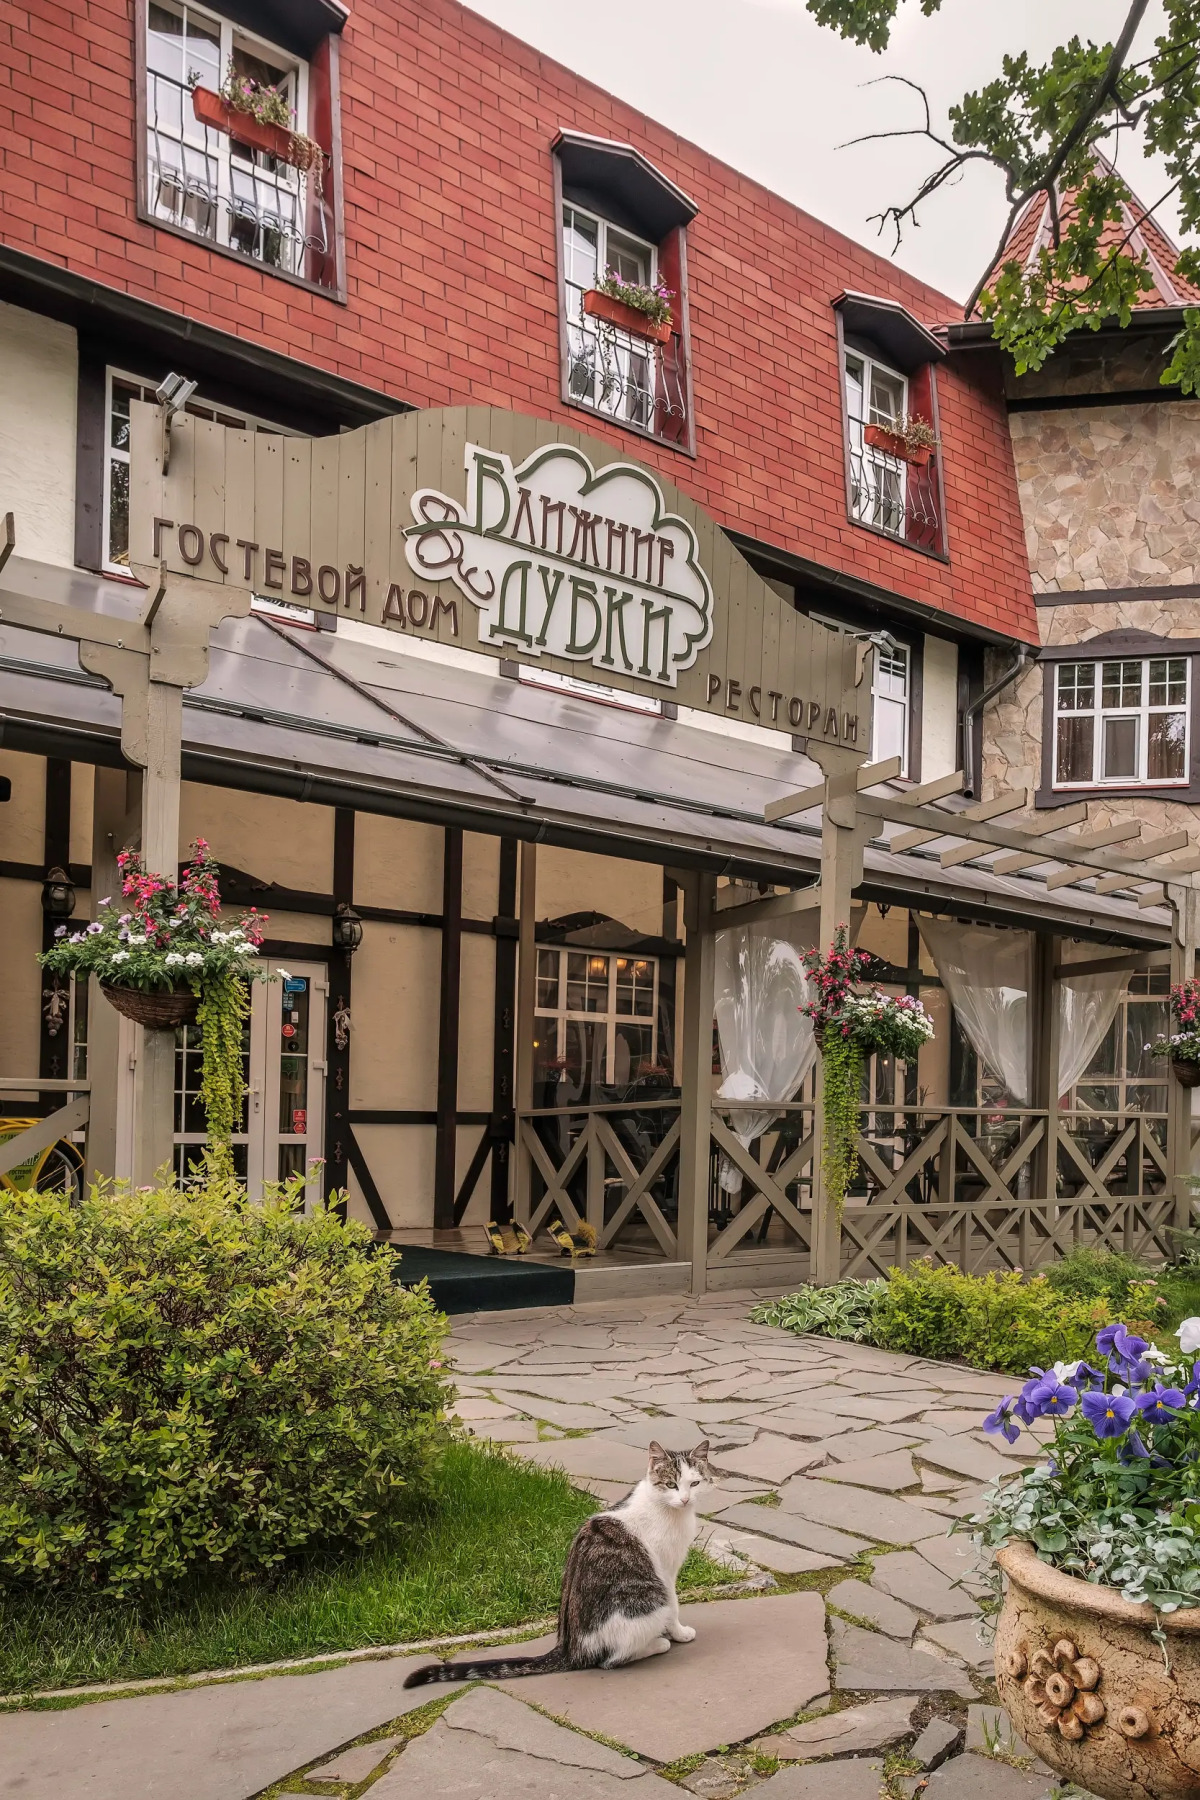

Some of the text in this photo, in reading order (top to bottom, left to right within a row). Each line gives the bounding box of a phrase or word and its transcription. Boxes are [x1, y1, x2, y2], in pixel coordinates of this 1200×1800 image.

[152, 516, 459, 637] ГОСТЕВОЙ ДОМ
[489, 560, 673, 681] ДУБКИ
[706, 673, 859, 743] РЕСТОРАН
